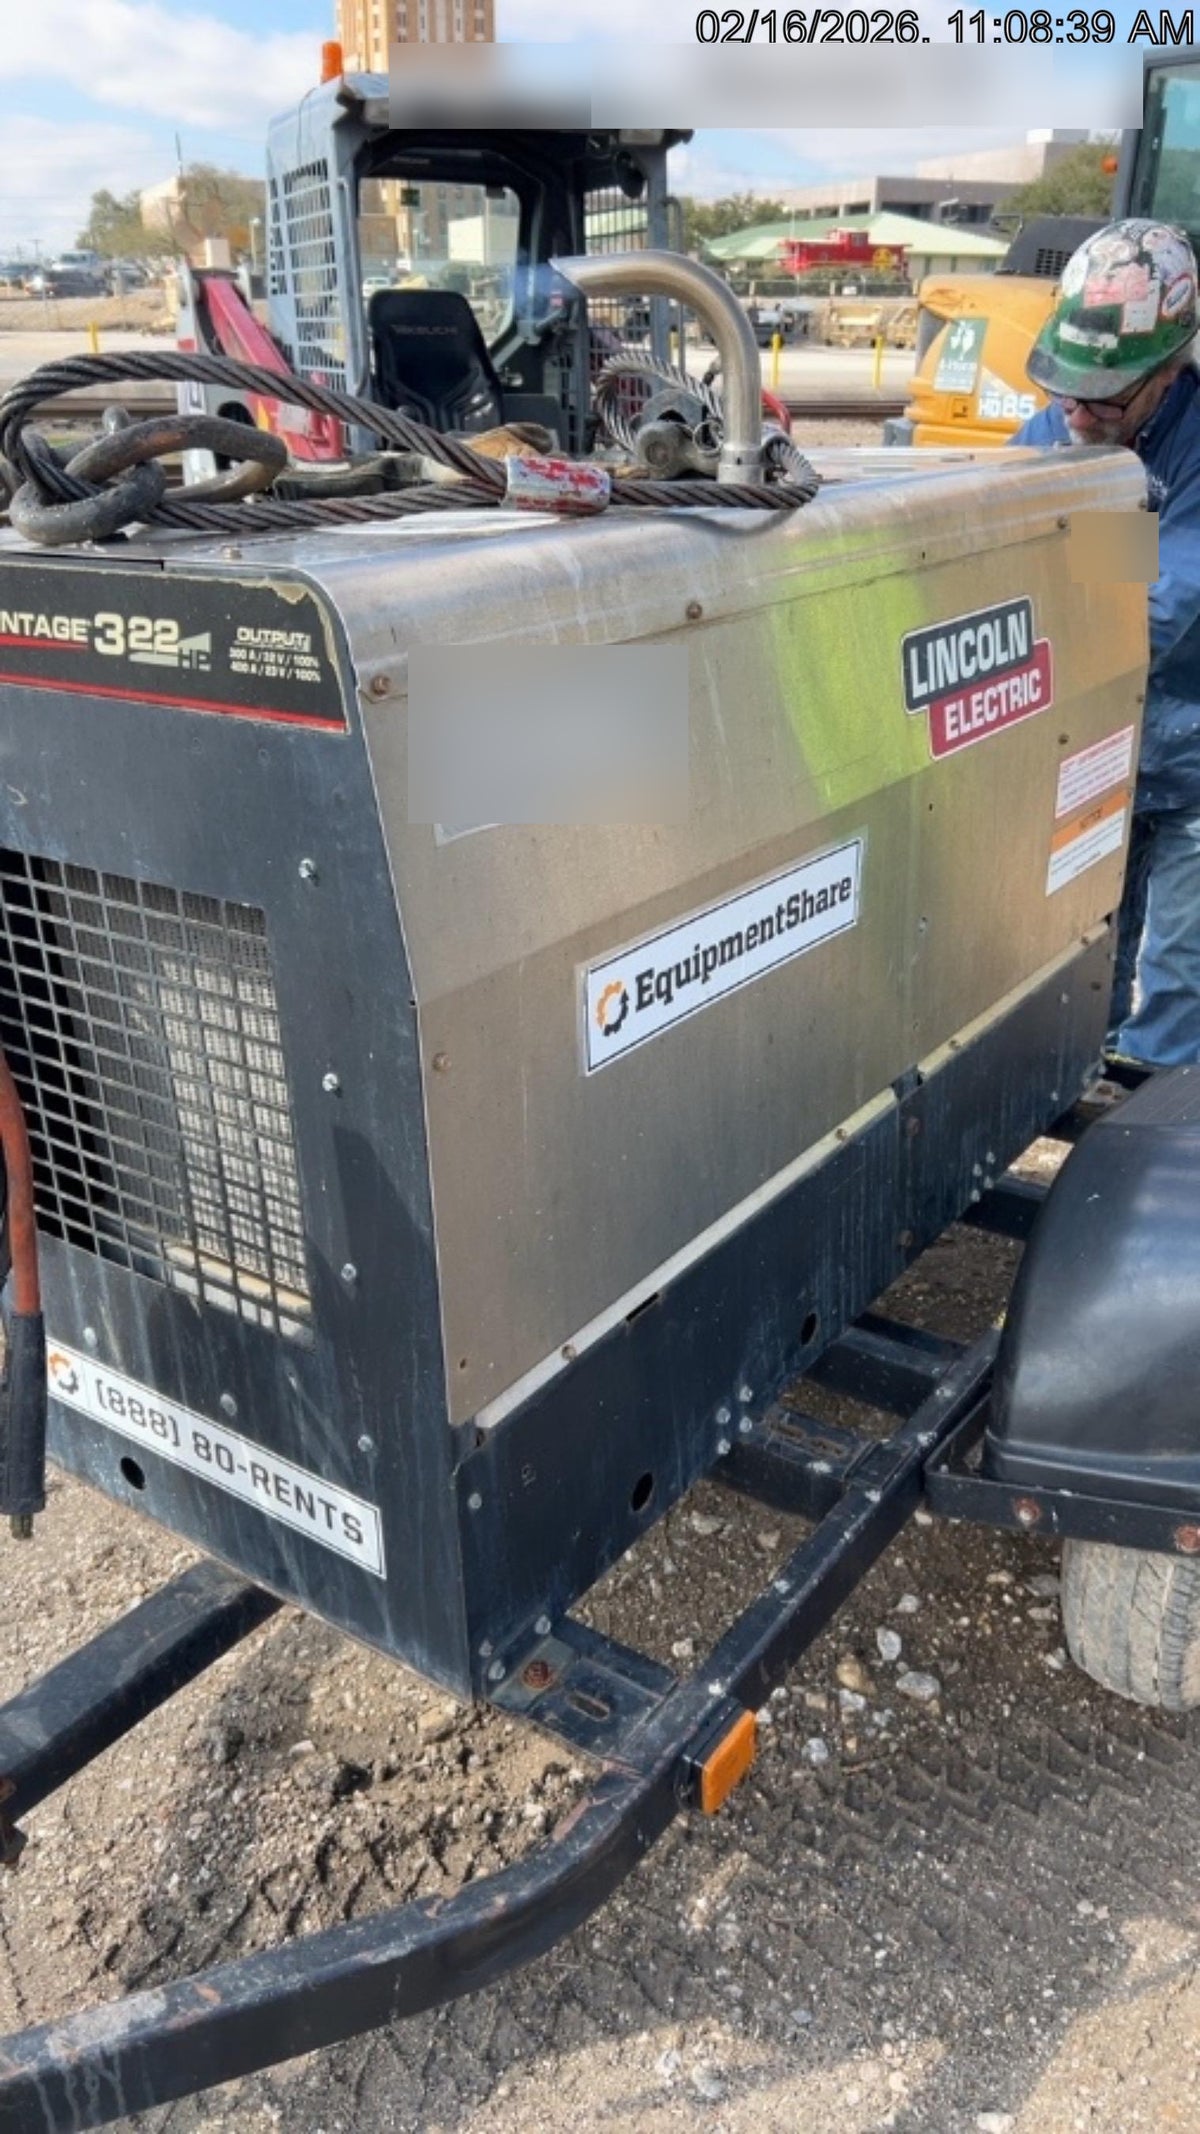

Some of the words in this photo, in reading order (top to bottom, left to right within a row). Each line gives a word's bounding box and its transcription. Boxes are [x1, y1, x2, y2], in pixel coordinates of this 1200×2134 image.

[0, 611, 89, 642] NTAGE
[94, 612, 179, 656] 322
[236, 626, 306, 647] OUTPUT
[910, 610, 1028, 699] LINCOLN
[944, 668, 1042, 741] ELECTRIC
[635, 876, 852, 1013] EquipmentShare
[95, 1378, 181, 1447] (888)
[192, 1430, 365, 1545] 80-RENTS
